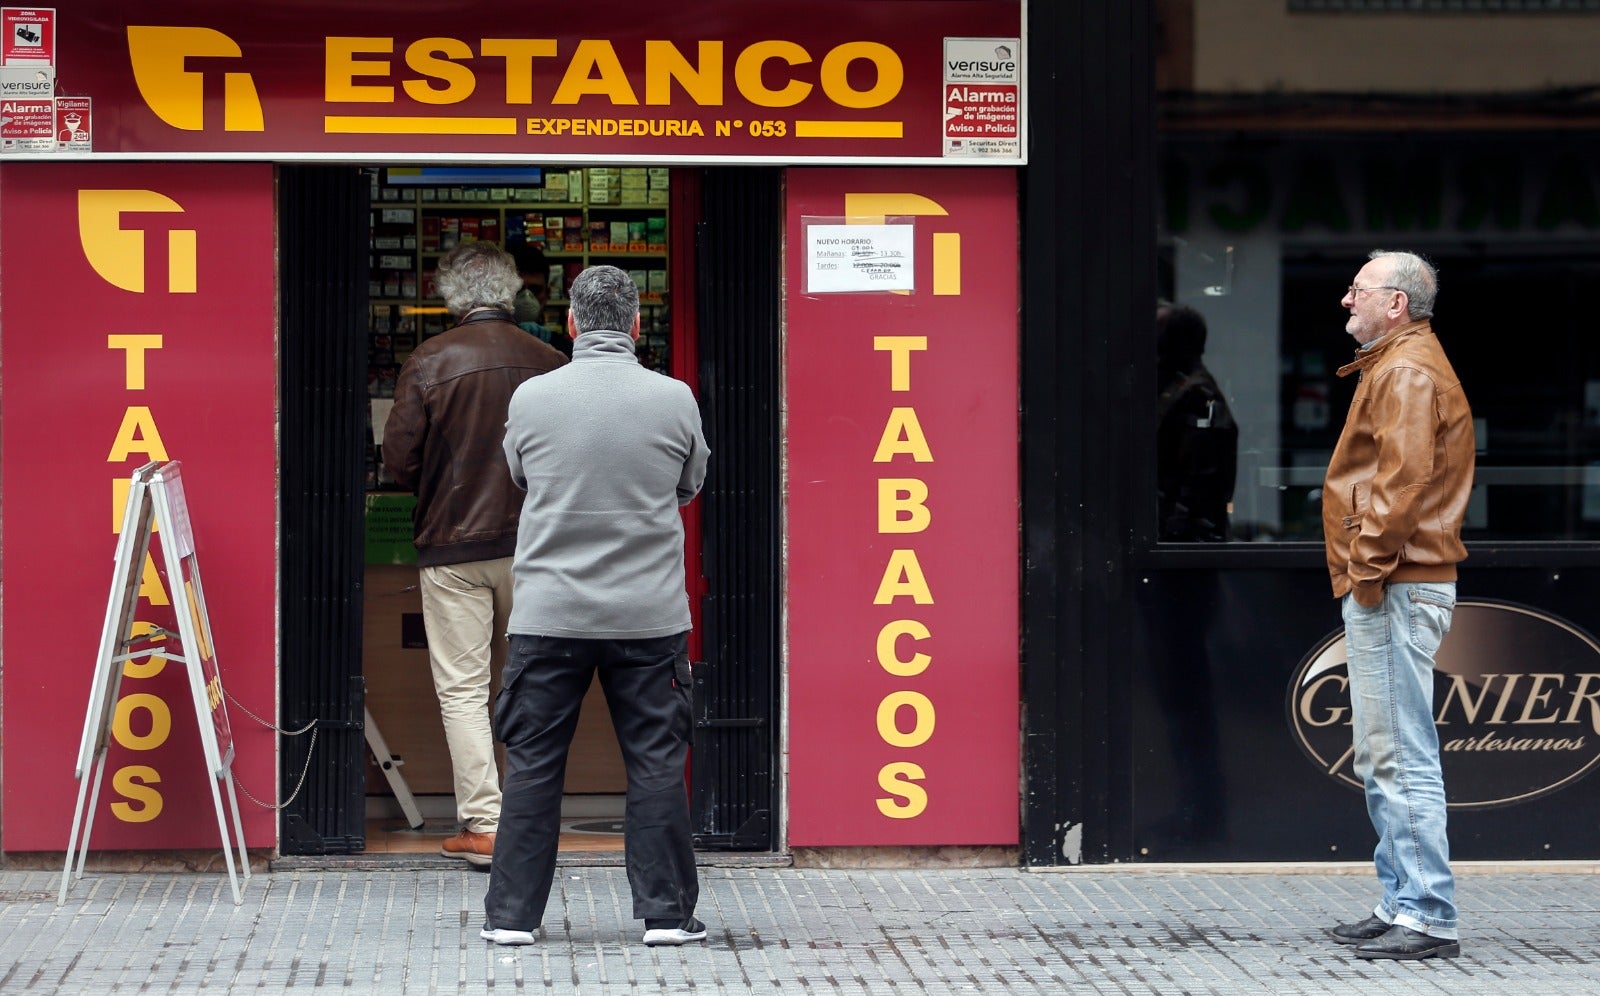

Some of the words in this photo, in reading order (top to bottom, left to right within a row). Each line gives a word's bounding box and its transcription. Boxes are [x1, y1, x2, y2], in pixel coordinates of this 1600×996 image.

[325, 36, 904, 108] ESTANCO
[948, 61, 1015, 72] verisure
[2, 81, 50, 90] verisure
[948, 87, 1015, 103] Alarma
[2, 102, 52, 113] Alarma
[57, 100, 88, 108] Vigilante
[979, 105, 1015, 113] grabación
[976, 112, 1015, 122] imágenes
[526, 118, 704, 137] EXPENDEDURIA
[750, 120, 786, 137] 053
[948, 124, 974, 132] Aviso
[985, 123, 1015, 133] Policía
[872, 336, 936, 818] TABACOS
[1300, 673, 1600, 735] GNIER
[1444, 731, 1586, 752] artesanos
